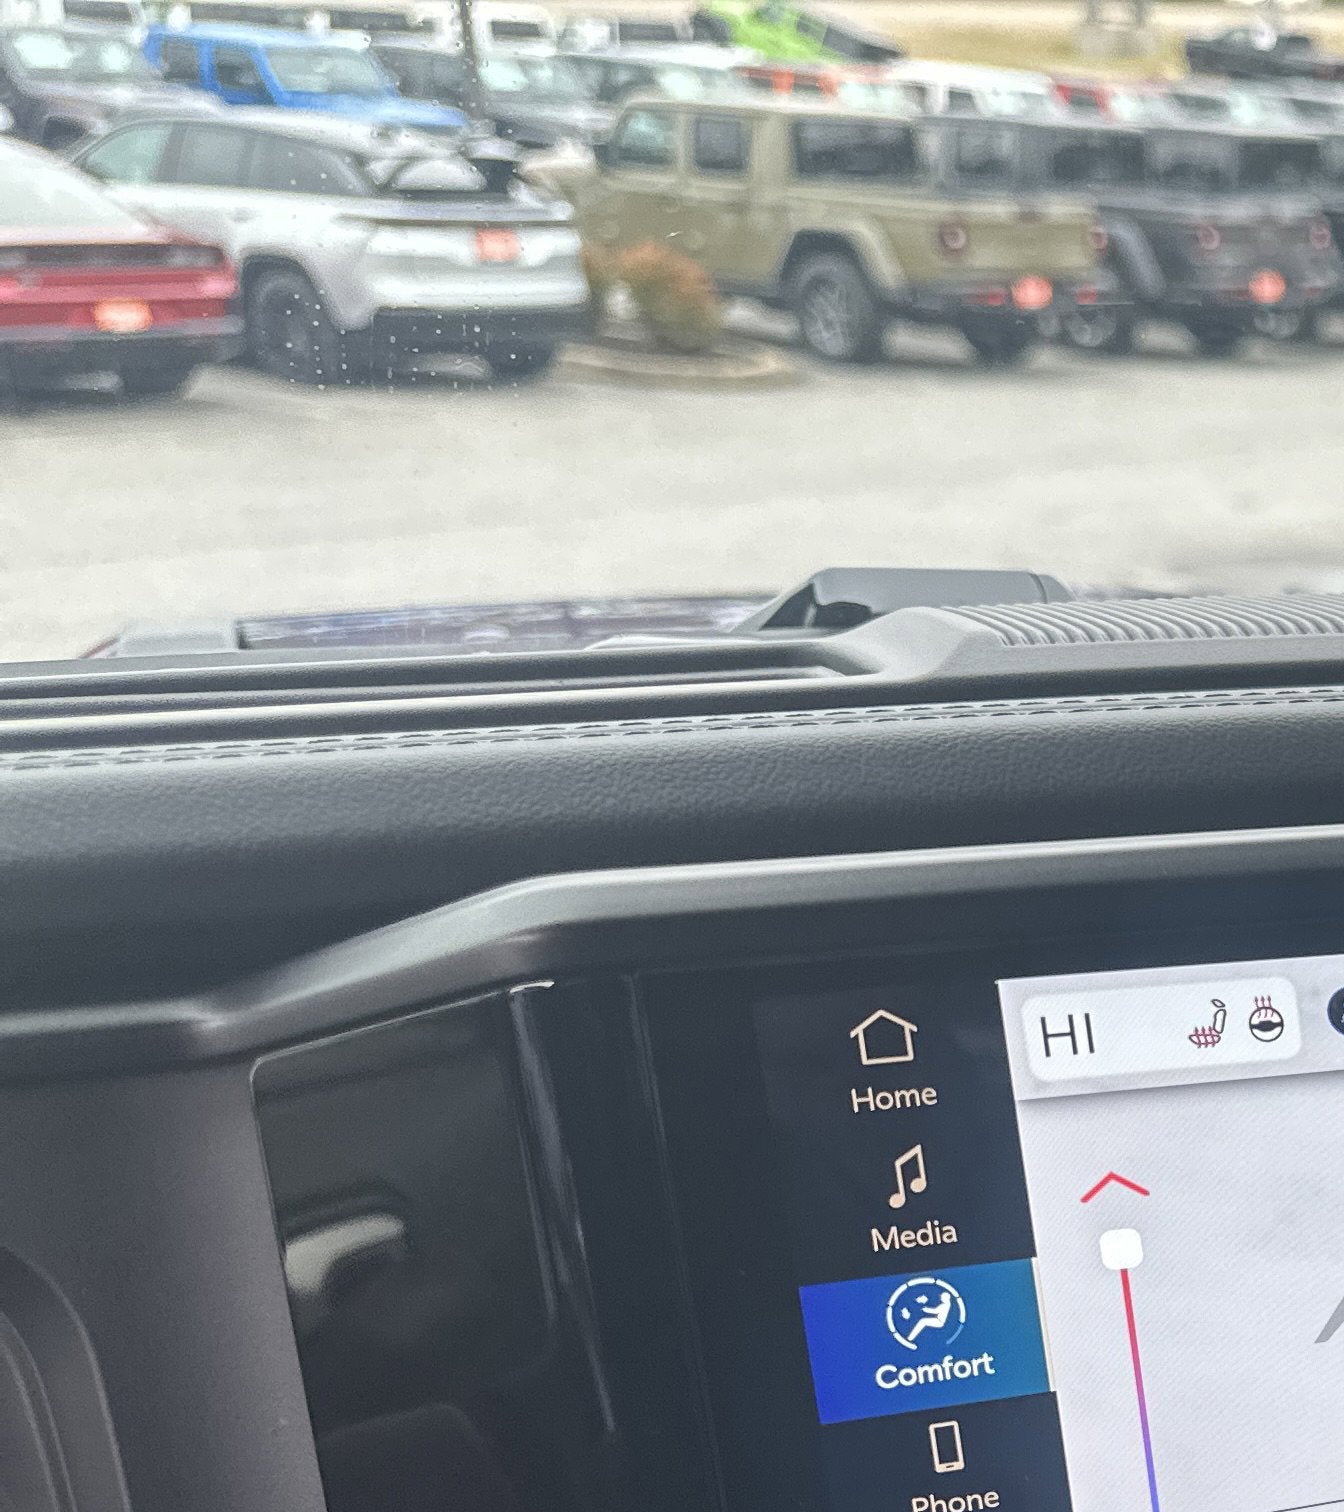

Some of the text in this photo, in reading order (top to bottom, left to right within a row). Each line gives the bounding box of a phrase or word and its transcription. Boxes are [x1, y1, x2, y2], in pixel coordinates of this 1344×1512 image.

[1040, 1012, 1095, 1058] HI
[850, 1084, 938, 1113] Home
[870, 1221, 959, 1252] Media
[875, 1352, 996, 1389] Comfort
